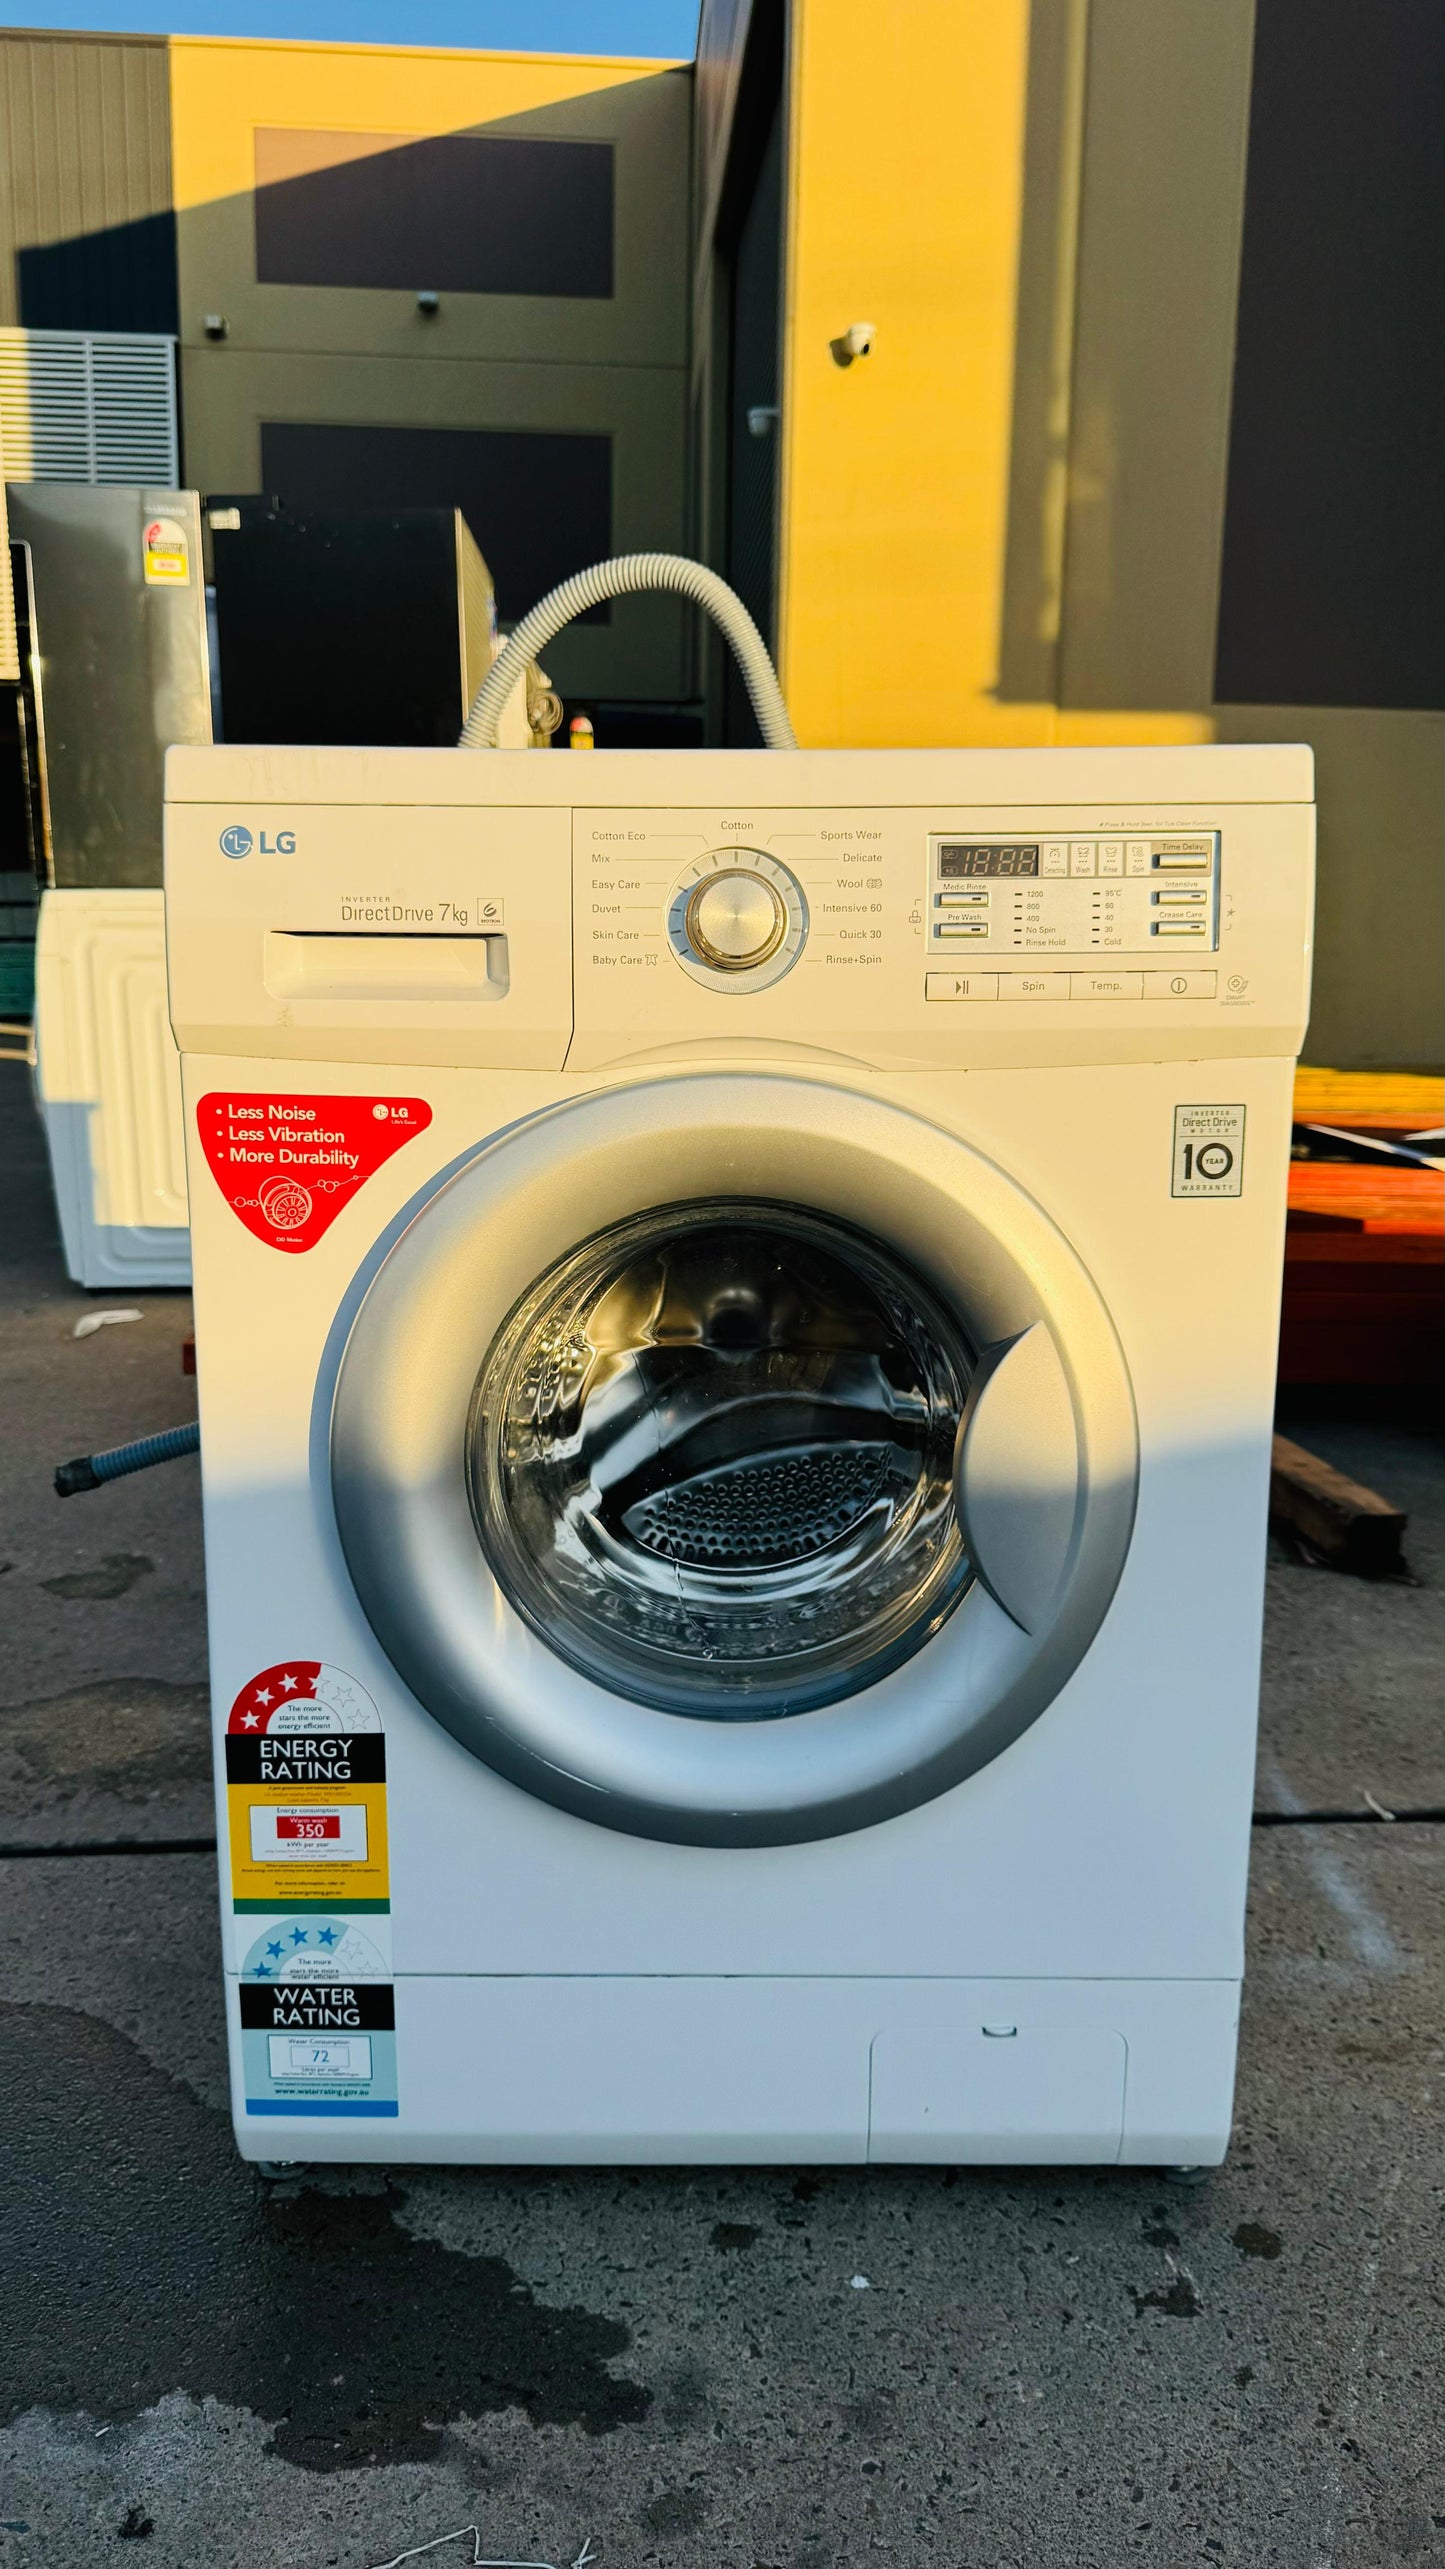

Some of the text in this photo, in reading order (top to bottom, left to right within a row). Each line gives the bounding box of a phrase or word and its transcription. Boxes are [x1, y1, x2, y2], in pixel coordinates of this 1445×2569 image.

[720, 821, 754, 830] Cotton
[592, 831, 646, 841] Cotton Eco
[820, 830, 882, 841] Sports Wear
[259, 831, 296, 854] LG
[1182, 843, 1204, 851] Delay
[592, 854, 610, 863] Mix
[843, 853, 882, 863] Delicate
[592, 880, 641, 891] Easy Care
[836, 879, 864, 888] Wool
[592, 904, 621, 913] Duvet
[823, 903, 882, 913] Intensive 60
[592, 930, 639, 940] Skin Care
[839, 930, 882, 940] Quick 30
[1040, 927, 1056, 935] Spin
[593, 956, 642, 966] Baby Care
[826, 955, 882, 966] Rinse+Spin
[1022, 981, 1045, 992] Spin
[1090, 981, 1122, 993] Temp.
[228, 1104, 316, 1121] Less Noise
[391, 1108, 408, 1118] LG
[1182, 1118, 1237, 1127] Direct Drive
[229, 1126, 345, 1143] Less Vibration
[230, 1148, 359, 1170] More Durability
[1183, 1142, 1233, 1180] 10
[260, 1740, 353, 1758] ENERGY
[261, 1761, 351, 1780] RATING
[297, 1824, 324, 1838] 350
[273, 1988, 357, 2005] WATER
[273, 2008, 360, 2026] RATING
[312, 2050, 329, 2063] 72
[275, 2088, 369, 2096] www.waterrating.gov.au
